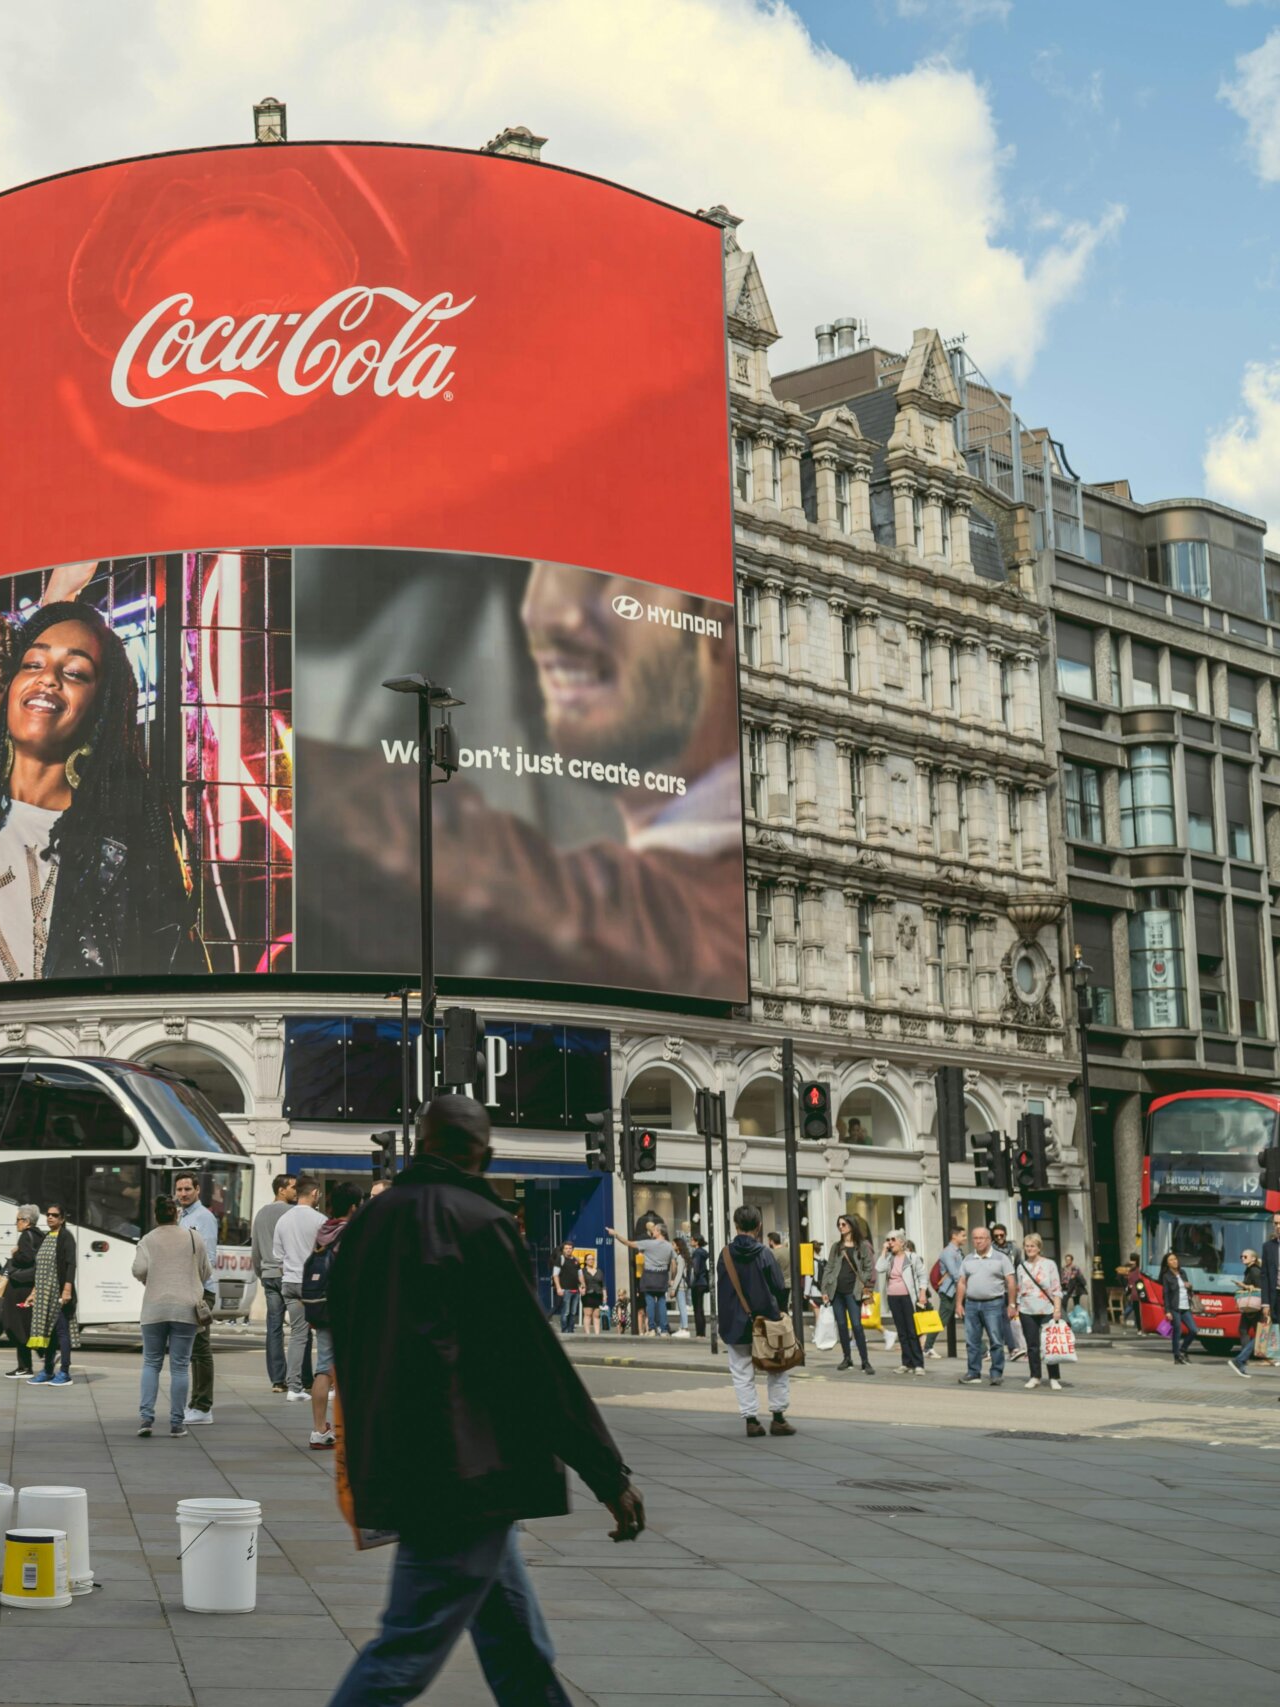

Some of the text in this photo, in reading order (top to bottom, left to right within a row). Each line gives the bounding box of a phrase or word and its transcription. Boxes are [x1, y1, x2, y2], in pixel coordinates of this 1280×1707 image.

[111, 286, 477, 408] Coca-Cola
[647, 604, 723, 639] HYUNDAI
[458, 746, 511, 770] on't
[515, 746, 563, 776] just
[568, 758, 640, 787] create
[643, 770, 687, 796] cars
[416, 1034, 508, 1107] GP
[1200, 1175, 1224, 1188] Bridge
[1242, 1177, 1260, 1193] 19
[217, 1254, 238, 1270] UTO
[1045, 1326, 1072, 1335] SALE
[1045, 1335, 1072, 1345] SALE
[1045, 1344, 1074, 1355] SALE
